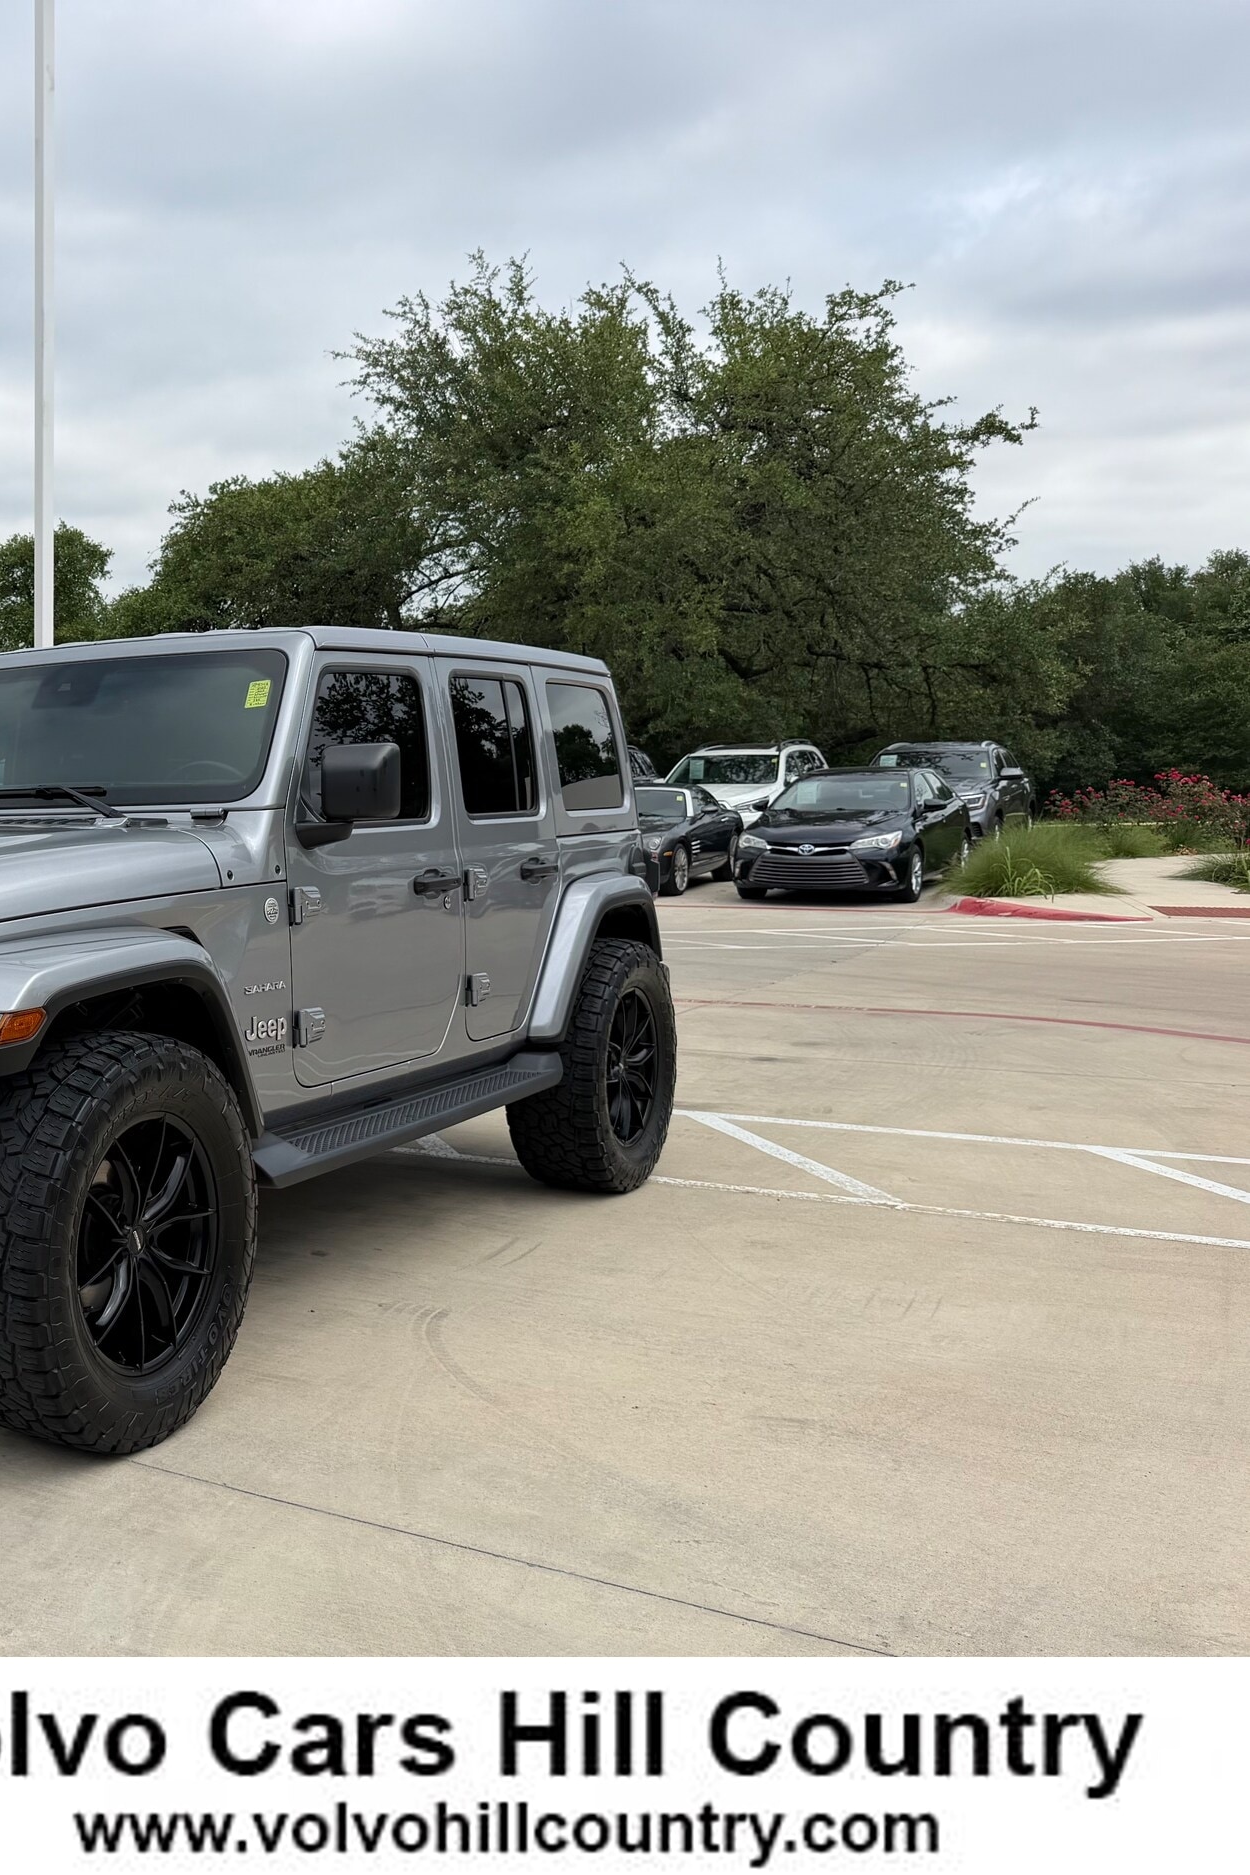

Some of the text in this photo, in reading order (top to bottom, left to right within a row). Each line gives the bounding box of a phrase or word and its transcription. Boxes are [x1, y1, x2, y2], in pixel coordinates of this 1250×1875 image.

[244, 981, 286, 995] SAHARA
[245, 1016, 288, 1042] Jeep
[248, 1043, 286, 1056] WRANGLER
